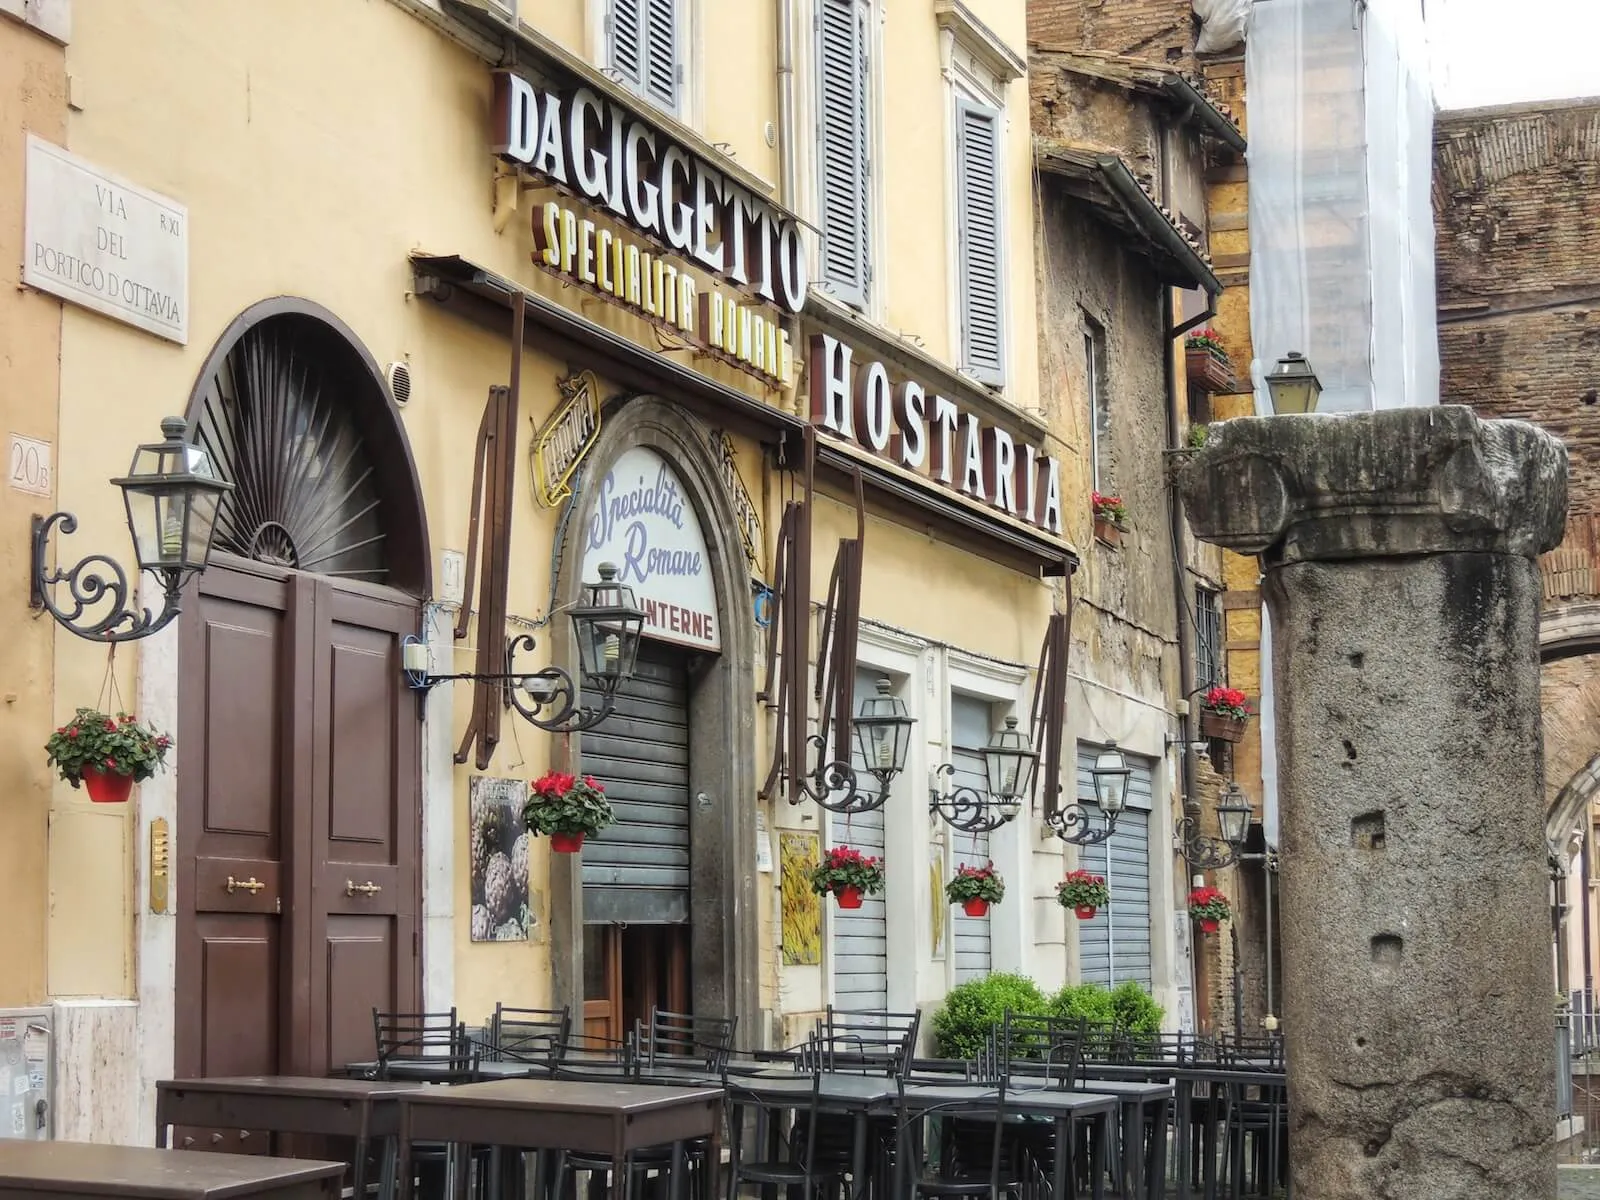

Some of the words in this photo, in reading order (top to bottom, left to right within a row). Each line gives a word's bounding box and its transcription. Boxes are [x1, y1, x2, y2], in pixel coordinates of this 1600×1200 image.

[95, 184, 127, 220] VIA
[34, 242, 104, 292] PORTICO
[97, 226, 127, 260] DEL
[821, 333, 1063, 537] HOSTARIA
[12, 442, 48, 489] 20B
[617, 520, 702, 584] Romane
